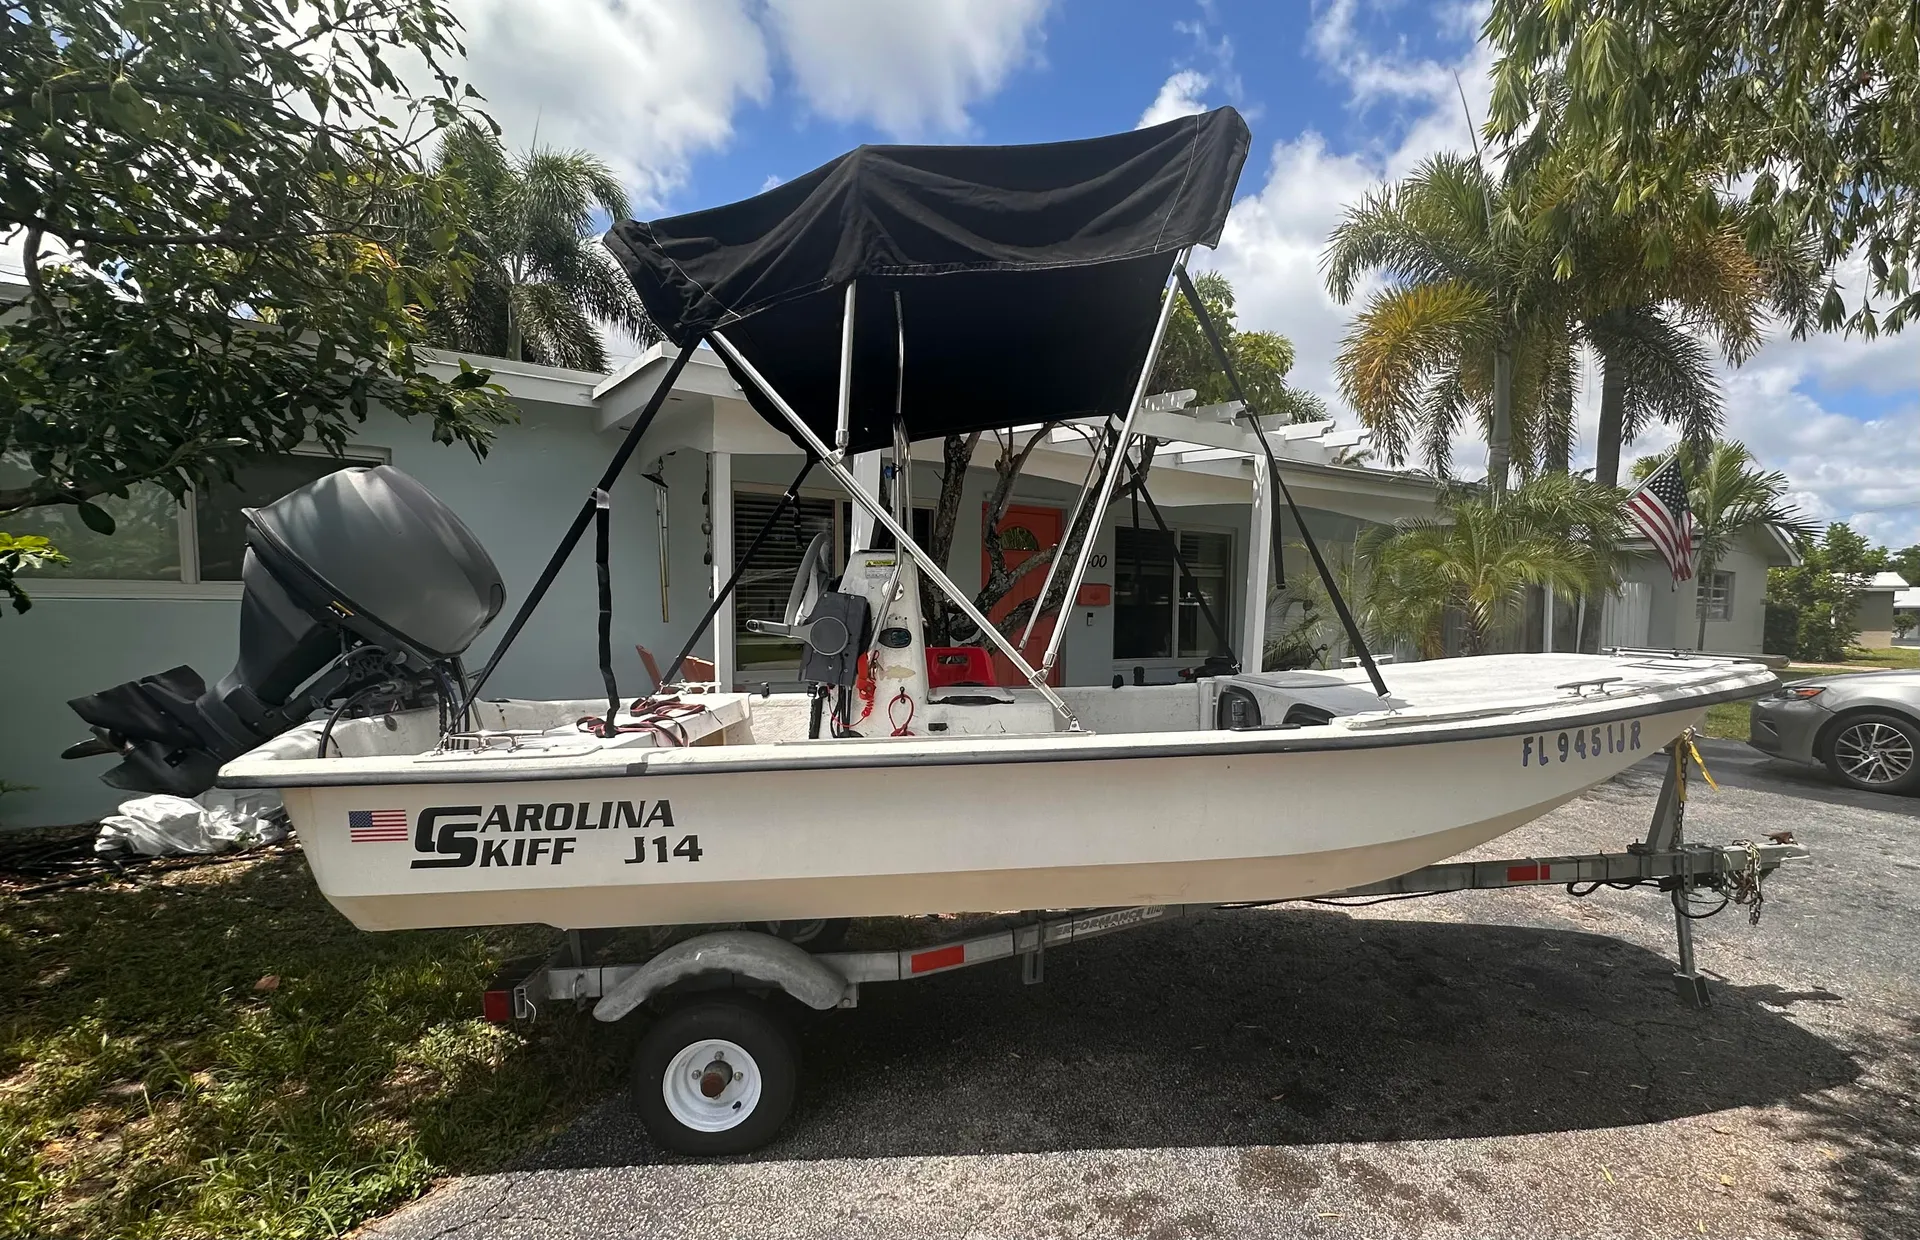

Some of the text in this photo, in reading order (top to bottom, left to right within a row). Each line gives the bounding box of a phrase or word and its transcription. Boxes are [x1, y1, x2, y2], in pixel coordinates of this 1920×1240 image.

[1088, 554, 1107, 568] 00
[1522, 736, 1548, 767] FL
[415, 800, 675, 852] CAROLINA
[410, 823, 703, 869] SKIFF J14
